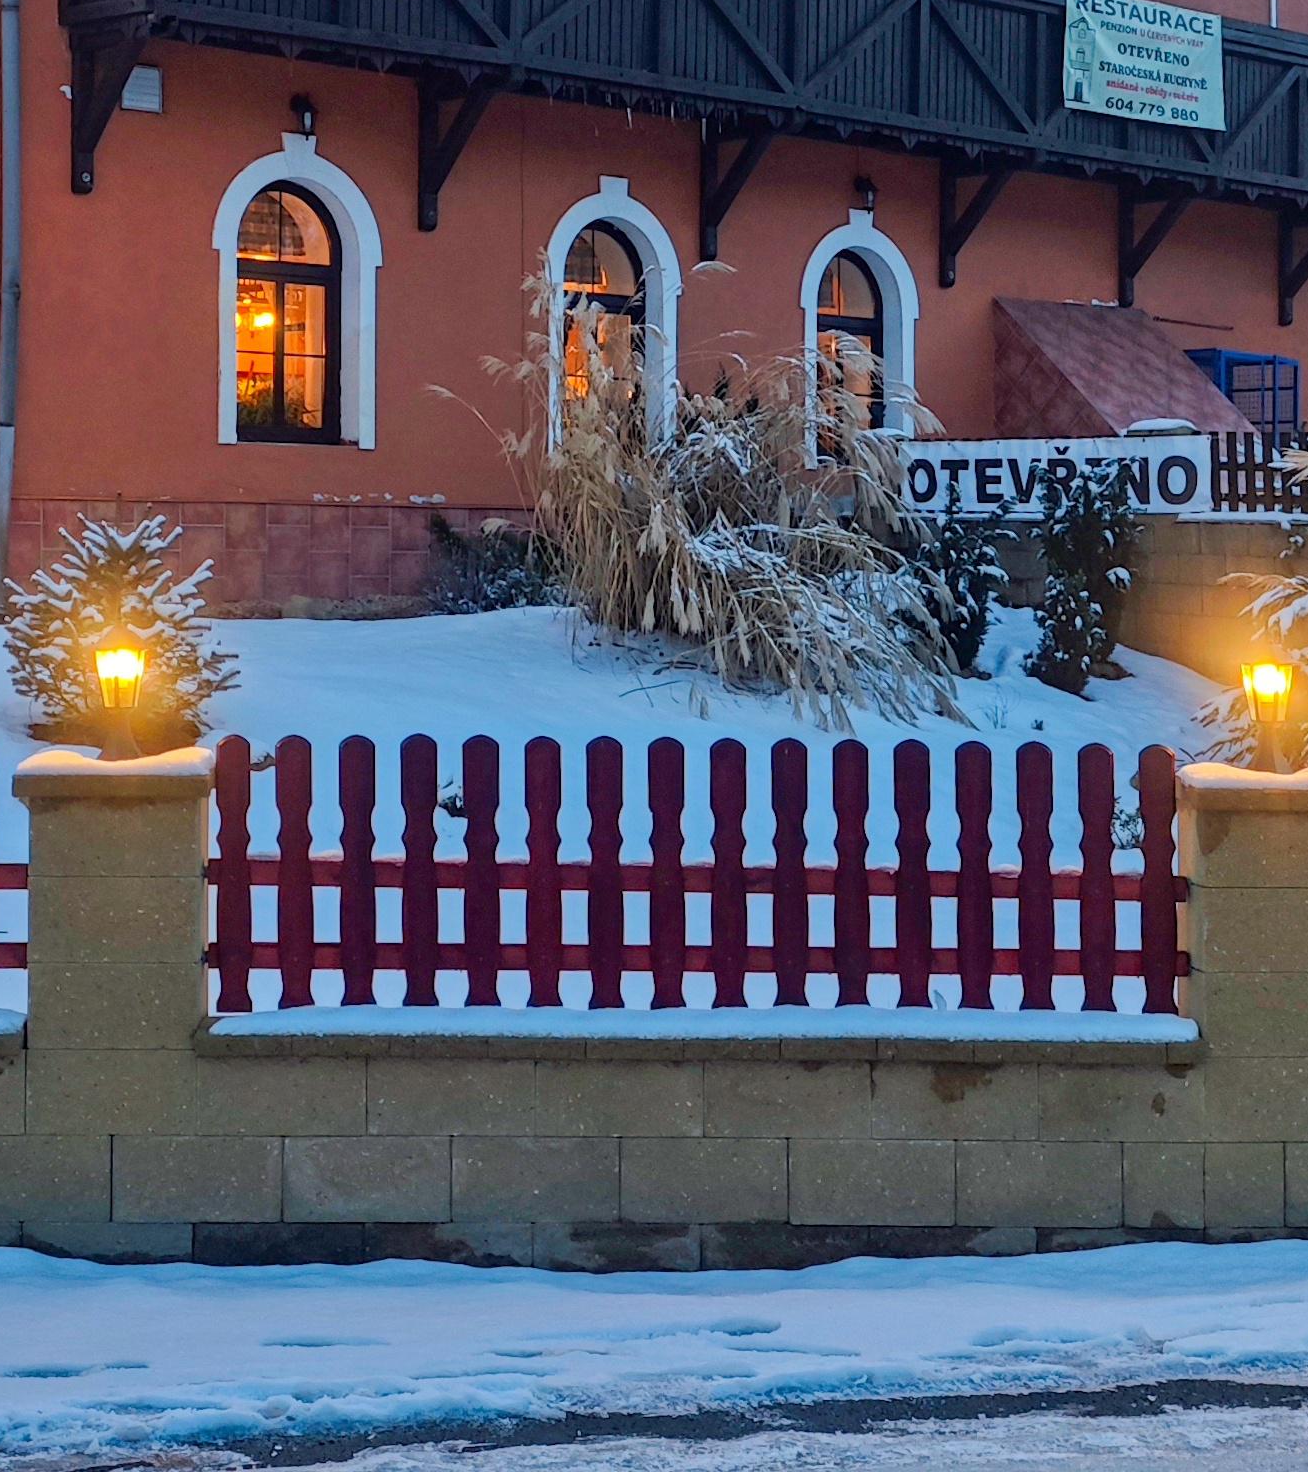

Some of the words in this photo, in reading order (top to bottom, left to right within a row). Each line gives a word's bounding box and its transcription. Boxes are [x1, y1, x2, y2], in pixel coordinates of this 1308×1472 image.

[1100, 20, 1138, 35] PENZION
[1117, 42, 1190, 67] OTEVŘENO
[1098, 60, 1161, 82] STAROČESKÁ
[1163, 73, 1208, 90] KUCHYNĚ
[1105, 96, 1133, 112] 604
[1139, 102, 1165, 117] 779
[1170, 107, 1199, 122] 880
[908, 446, 1198, 505] OTEVŘNO
